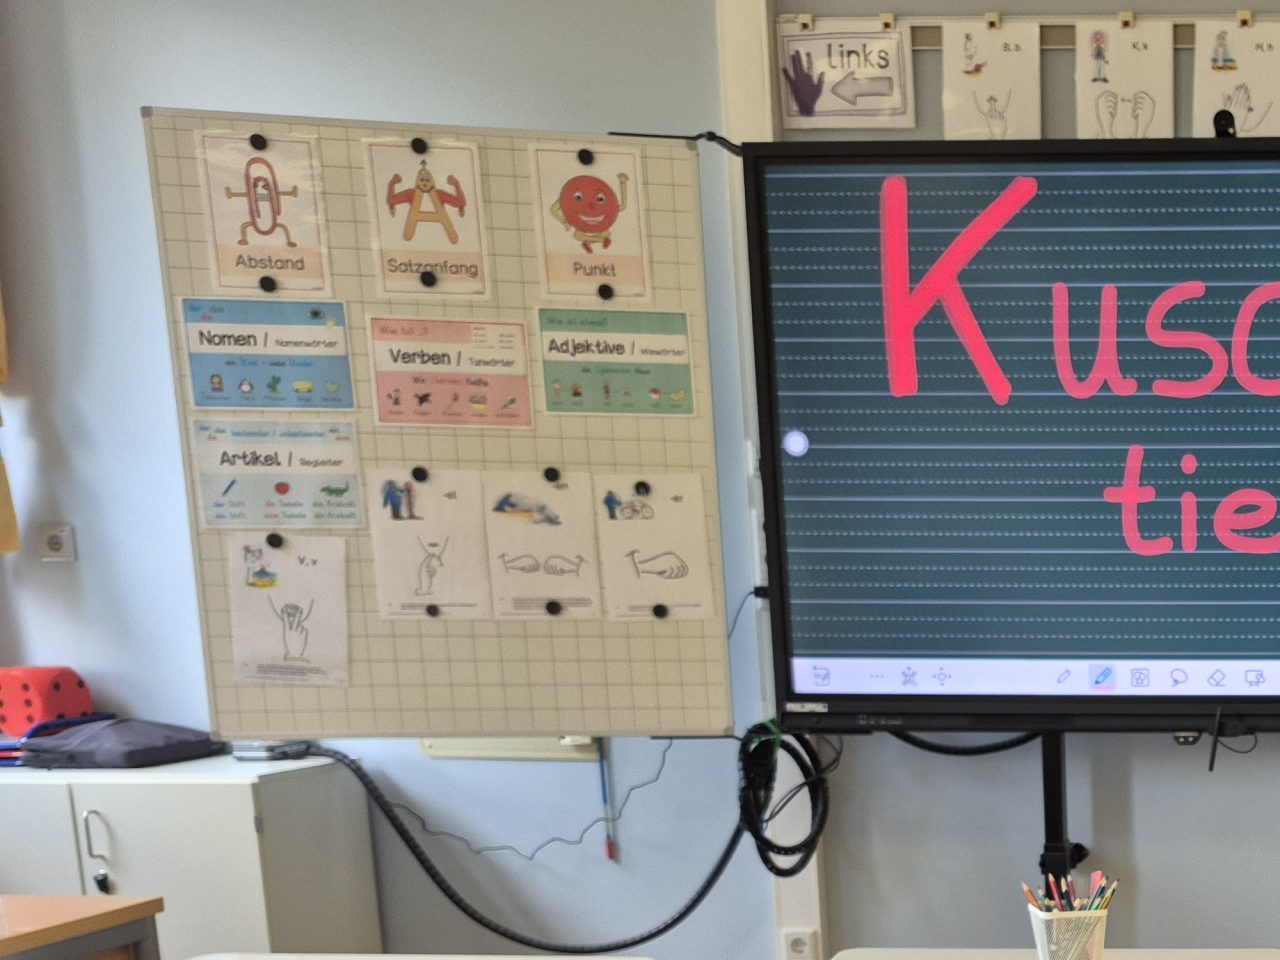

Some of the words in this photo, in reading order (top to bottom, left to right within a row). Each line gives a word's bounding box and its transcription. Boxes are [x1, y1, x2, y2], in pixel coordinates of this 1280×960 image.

[826, 42, 890, 70] links
[235, 254, 305, 271] Abstand
[387, 257, 479, 278] Satzanfang
[573, 261, 617, 277] Punkt
[198, 330, 257, 347] Nomen
[549, 337, 625, 357] Adjektive
[389, 348, 450, 365] Verben
[219, 451, 282, 467] Artikel
